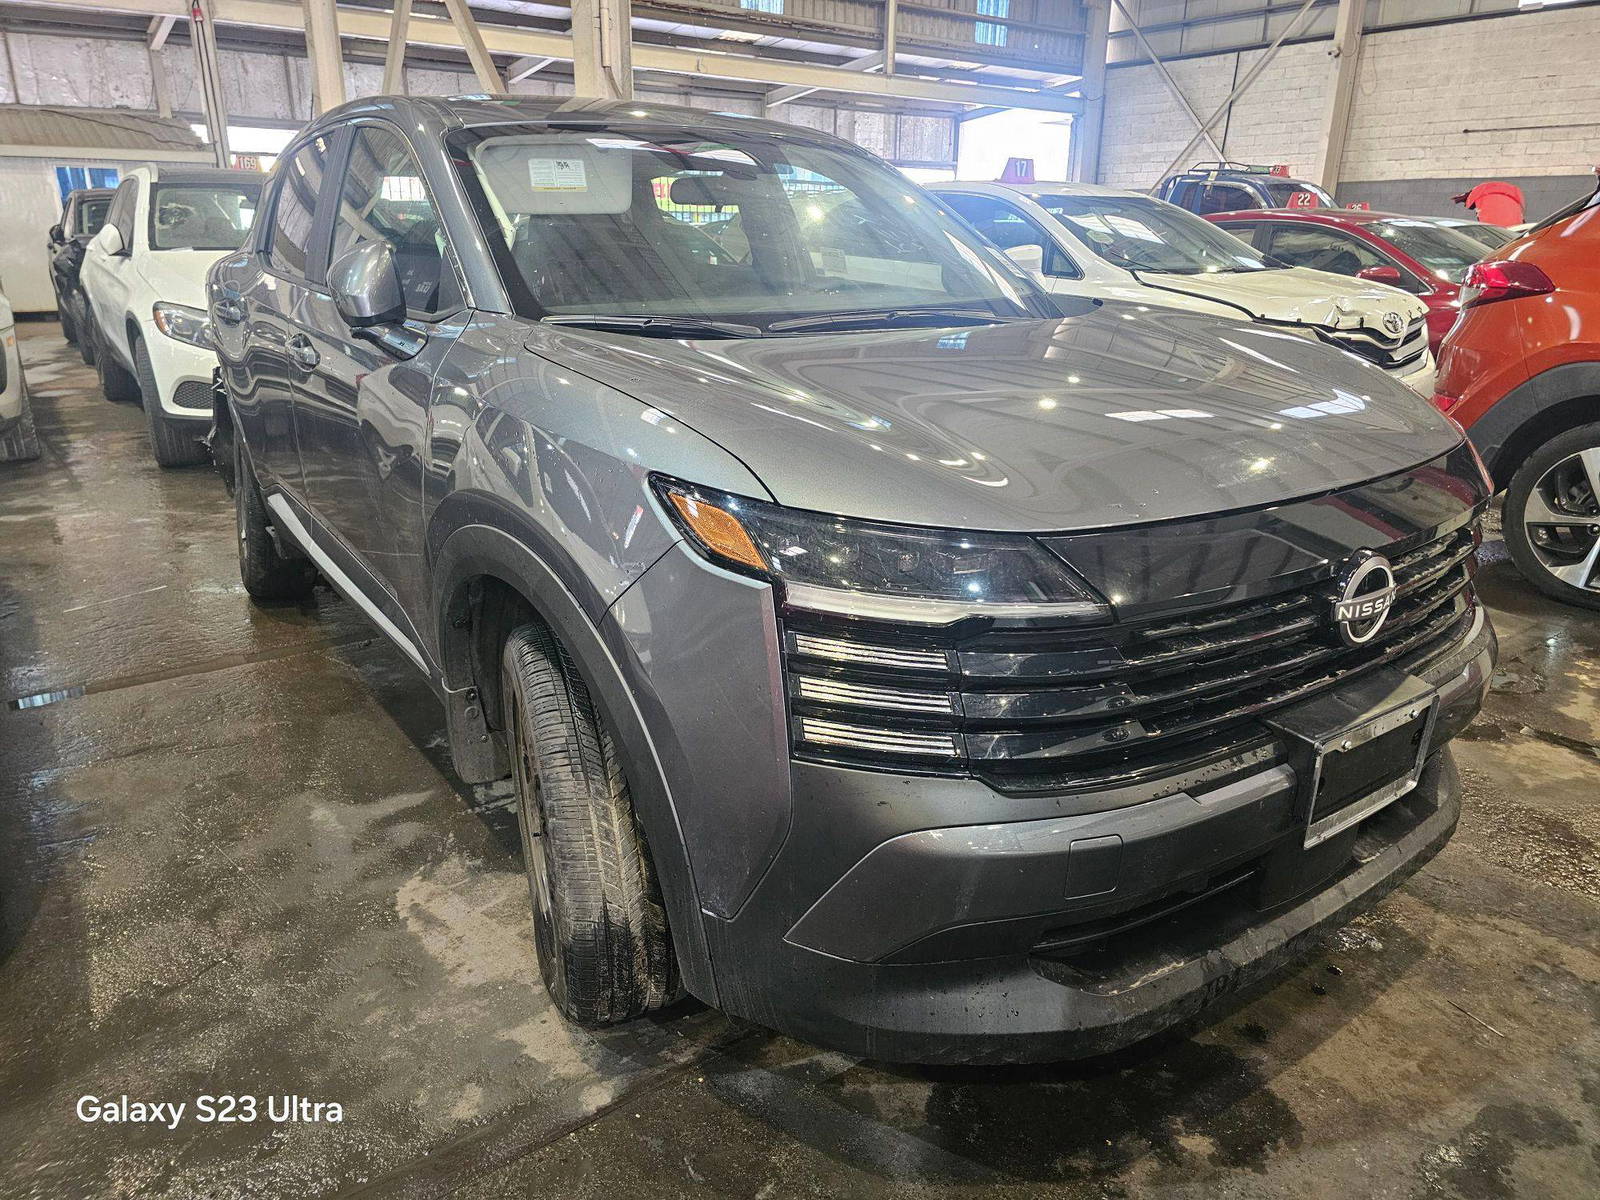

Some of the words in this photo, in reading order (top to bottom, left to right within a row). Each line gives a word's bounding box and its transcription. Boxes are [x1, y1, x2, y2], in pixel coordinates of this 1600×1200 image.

[238, 156, 257, 169] 169
[1016, 160, 1027, 177] 17
[1298, 193, 1310, 206] 22
